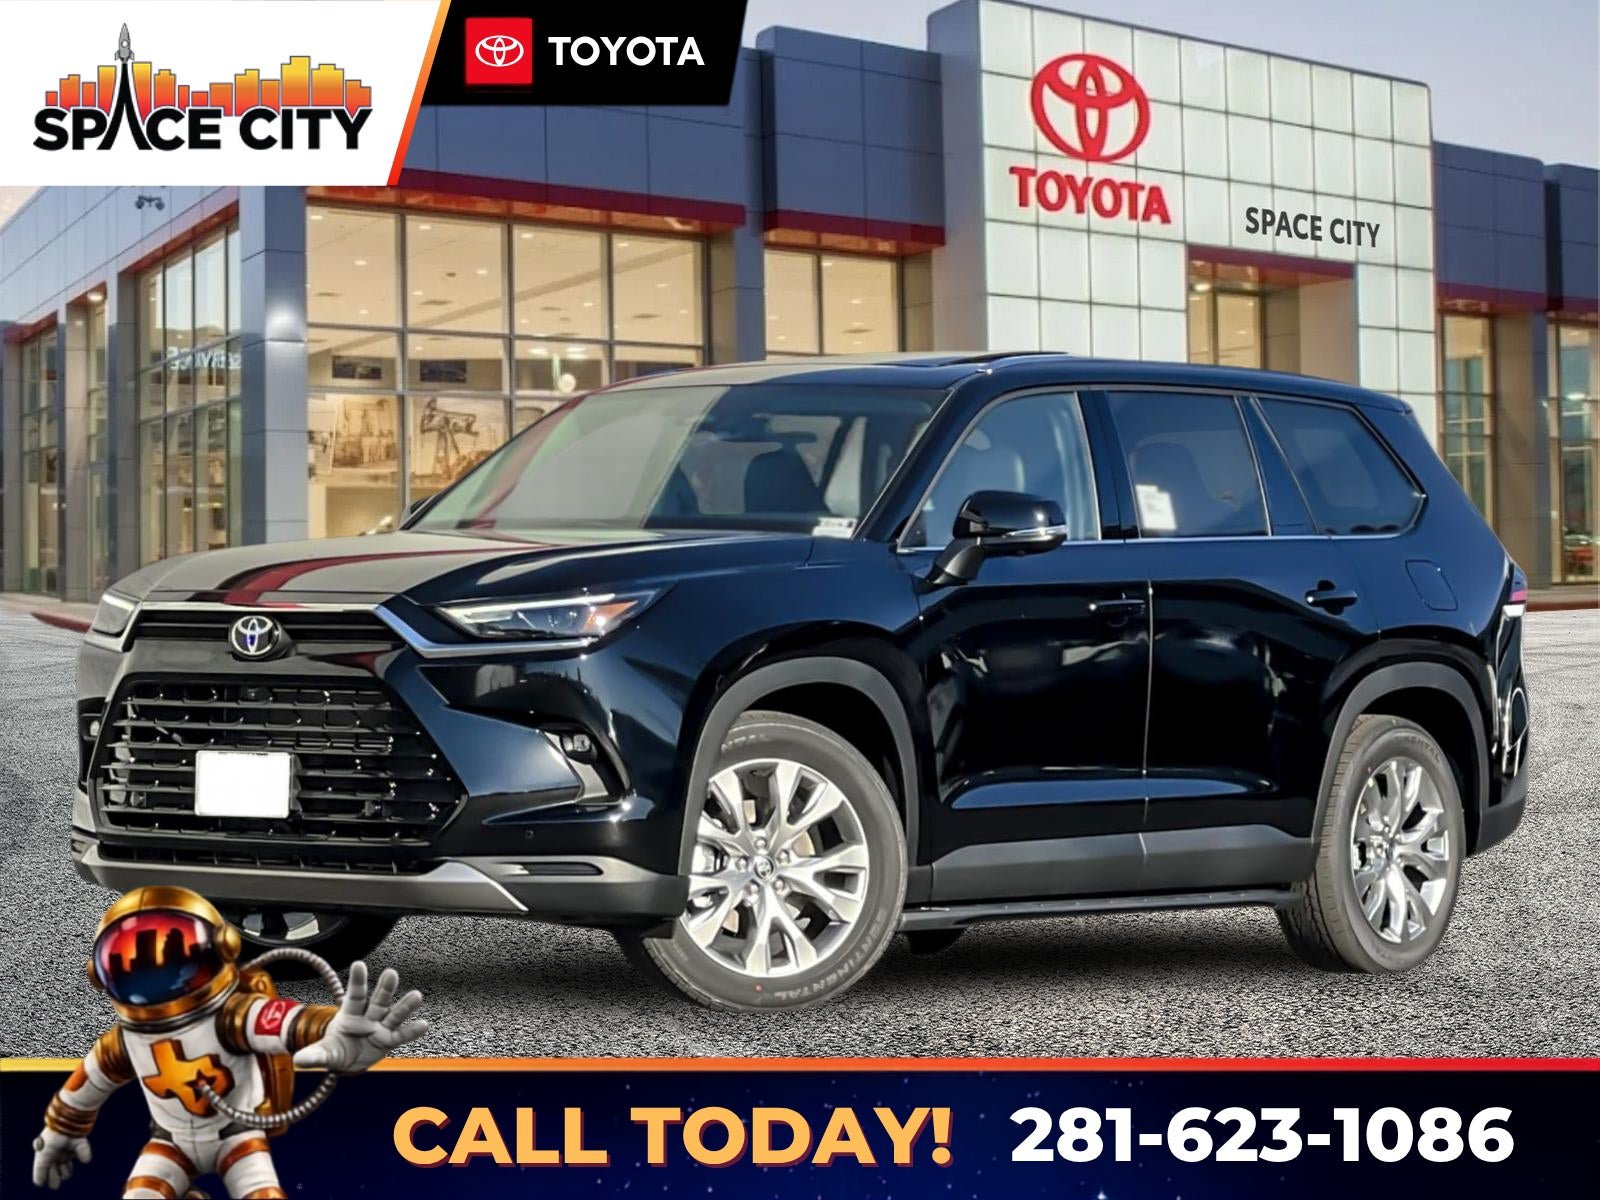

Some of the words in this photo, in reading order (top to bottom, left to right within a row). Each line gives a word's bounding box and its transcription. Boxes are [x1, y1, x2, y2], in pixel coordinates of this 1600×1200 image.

[1009, 165, 1171, 224] TOYOTA
[1245, 206, 1322, 242] SPACE
[1329, 217, 1381, 249] CITY
